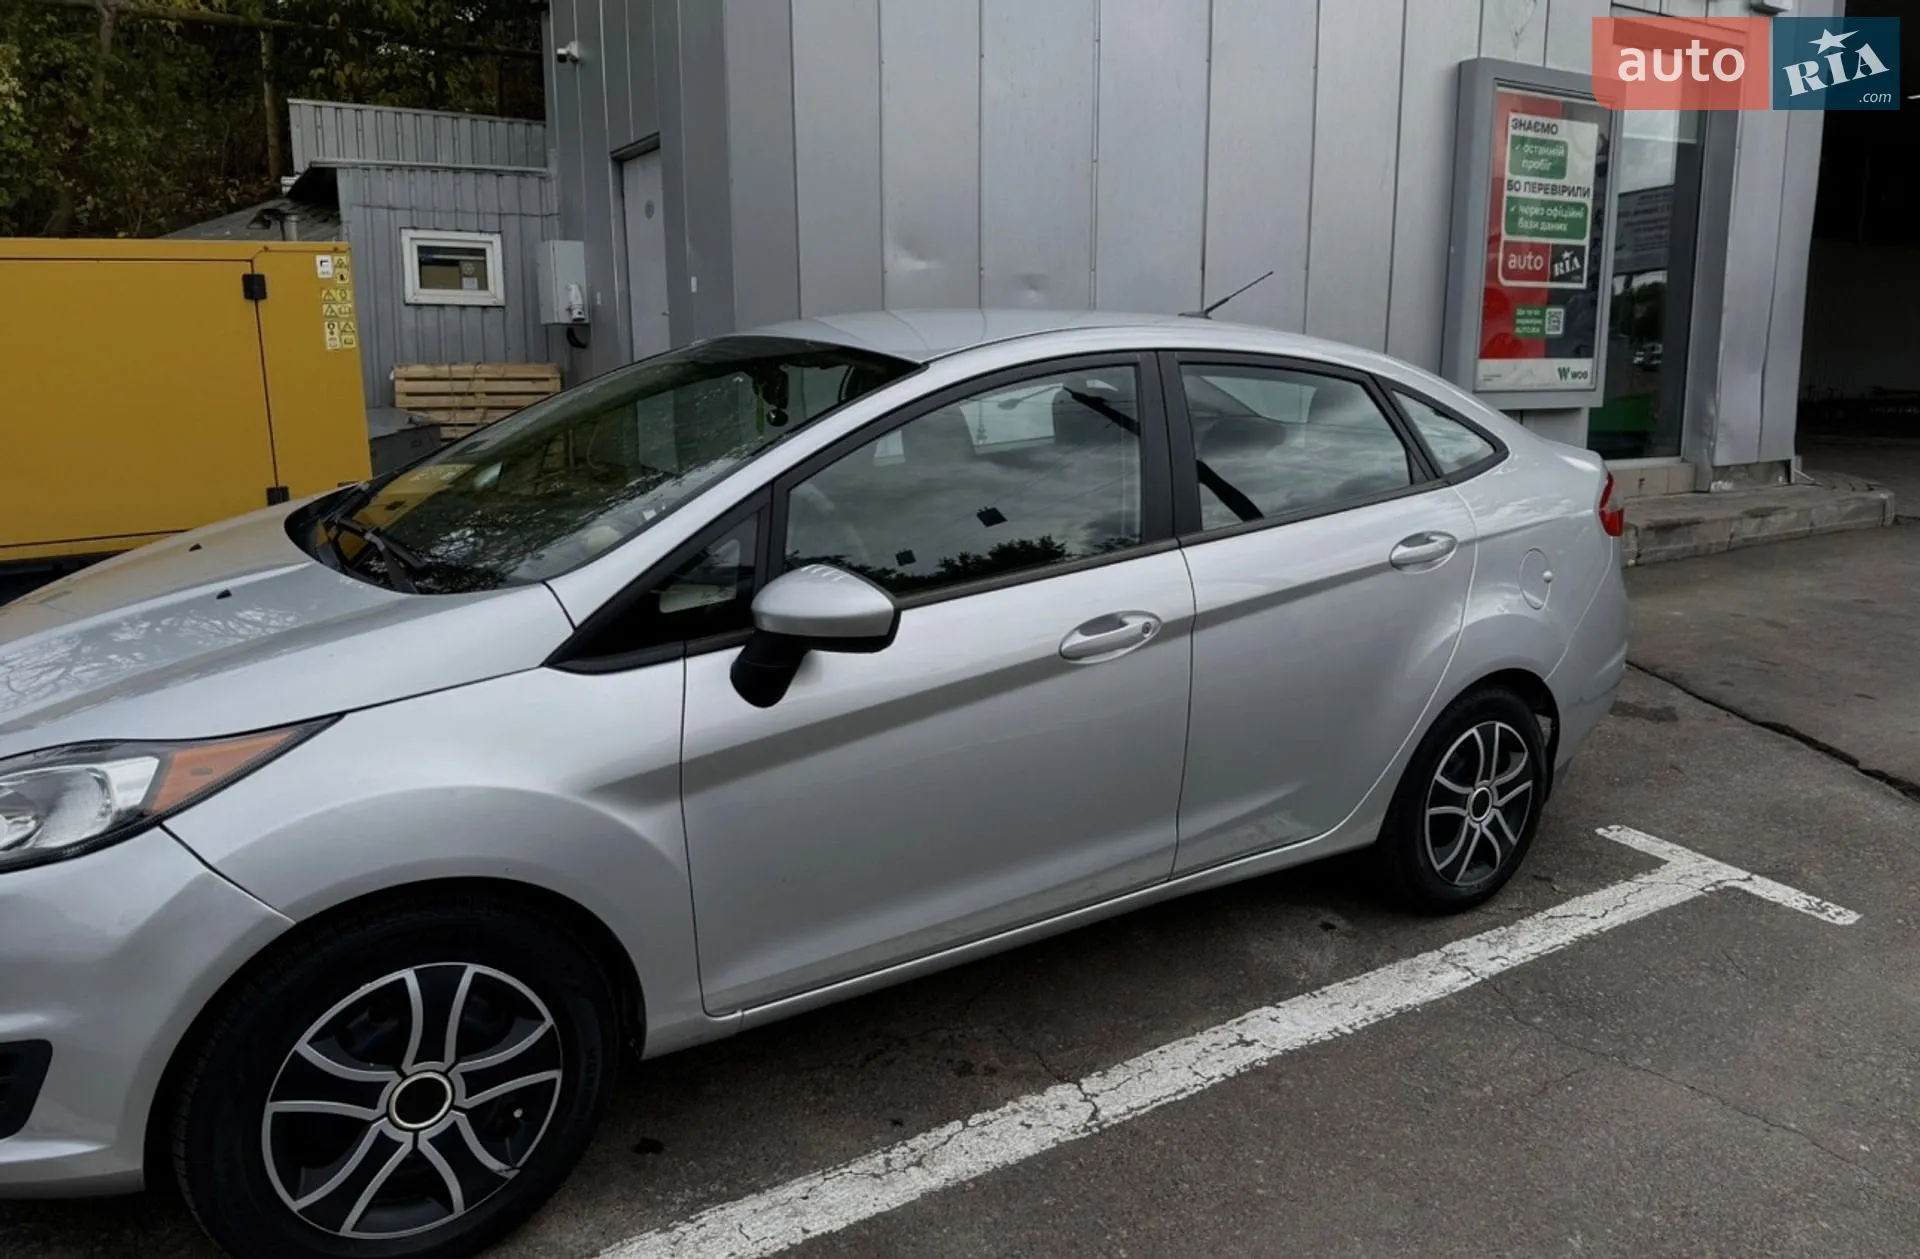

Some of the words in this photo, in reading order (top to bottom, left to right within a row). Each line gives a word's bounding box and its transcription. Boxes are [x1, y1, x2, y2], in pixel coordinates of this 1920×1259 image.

[1511, 118, 1559, 135] ЗНАЄМО
[1507, 179, 1521, 192] БО
[1523, 180, 1591, 199] ПЕРЕВІРИЛИ
[1519, 204, 1545, 218] через
[1546, 206, 1584, 219] офіційні
[1518, 216, 1539, 229] бази
[1540, 221, 1568, 232] даних
[1508, 251, 1544, 271] auto
[1553, 256, 1582, 277] RIA
